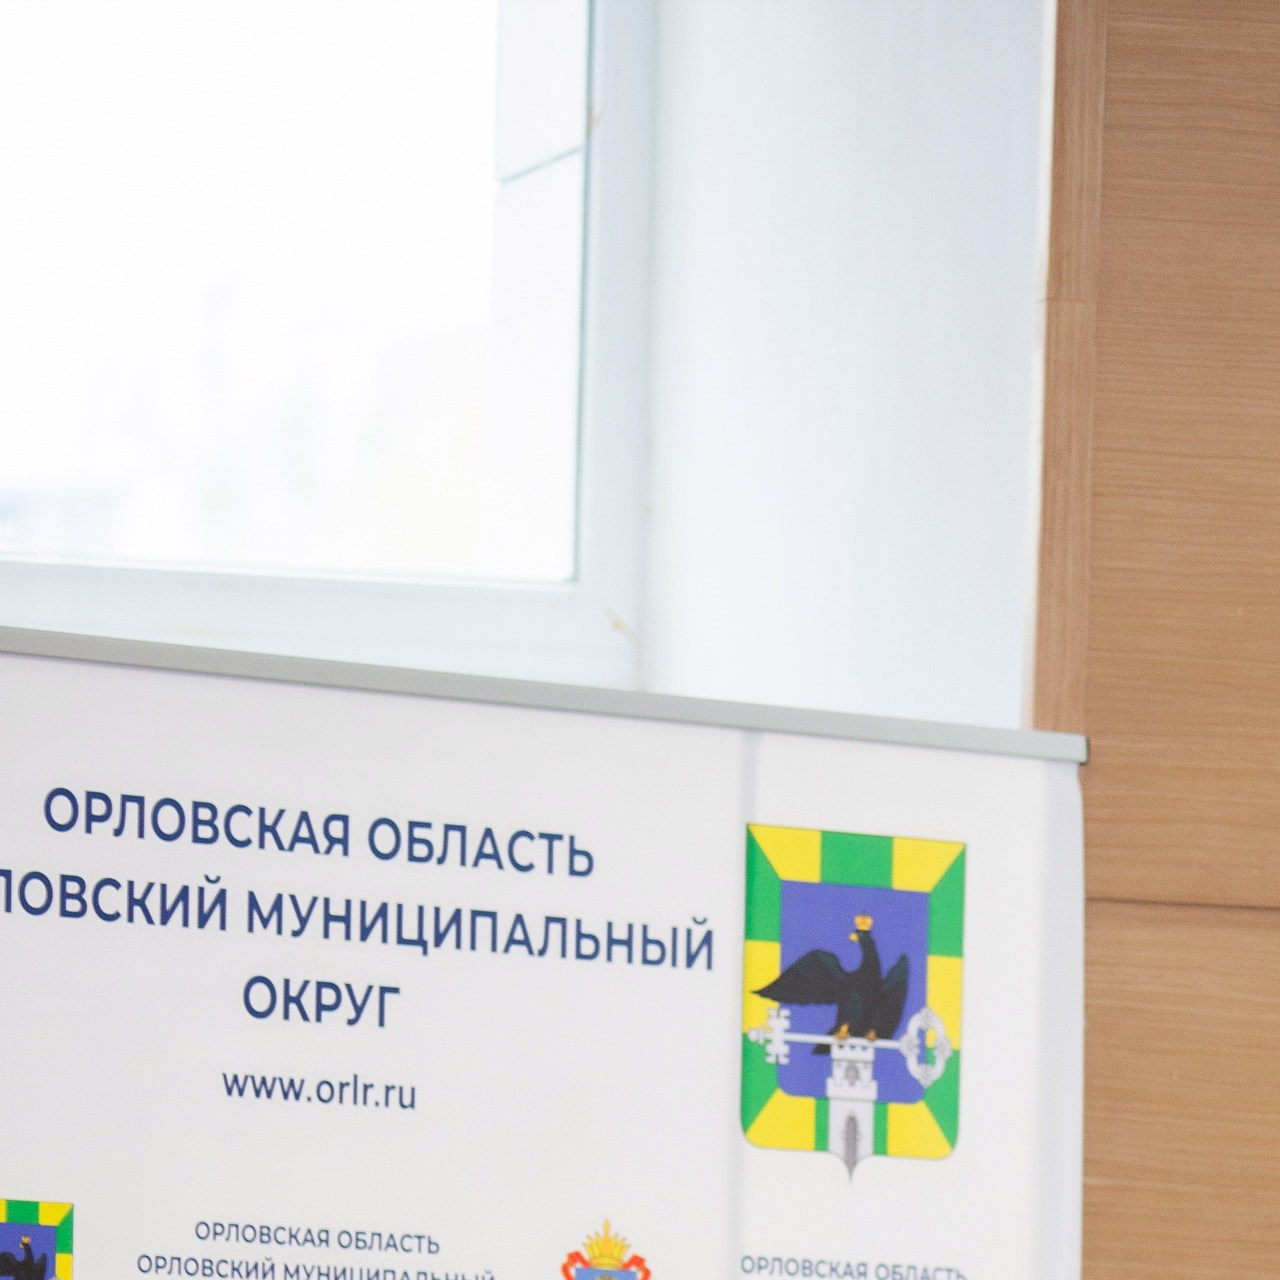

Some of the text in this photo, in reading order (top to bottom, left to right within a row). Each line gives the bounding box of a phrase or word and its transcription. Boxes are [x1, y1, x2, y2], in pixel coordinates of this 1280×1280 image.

[43, 787, 594, 878] ОРЛОВСКАЯ ОБЛАСТЬ
[0, 869, 714, 972] ОВСКИЙ МУНИЦИПАЛЬНЫЙ
[243, 975, 400, 1029] ОКРУГ
[222, 1073, 416, 1110] www.orlr.ru
[194, 1220, 441, 1256] ОРЛОВСКАЯ ОБЛАСТЬ
[739, 1254, 869, 1280] ОРЛОВСКАЯ
